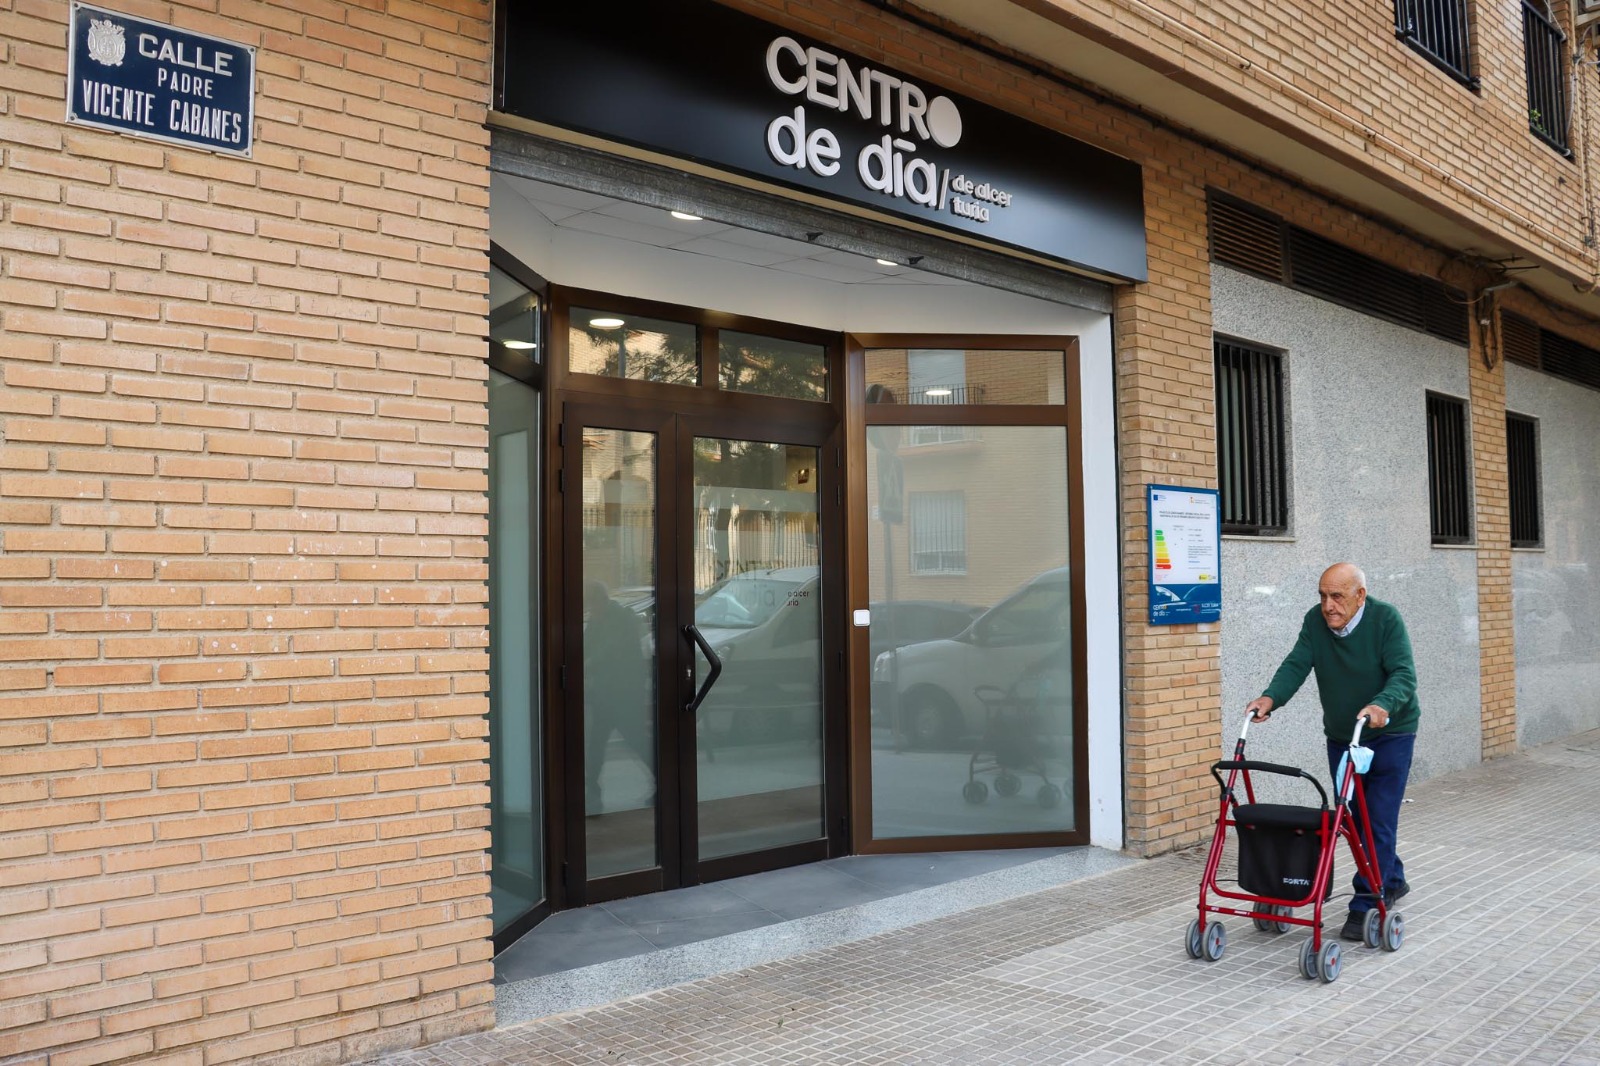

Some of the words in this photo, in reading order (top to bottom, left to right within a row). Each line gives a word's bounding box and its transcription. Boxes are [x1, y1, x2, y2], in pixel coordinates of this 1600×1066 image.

[138, 32, 233, 77] CALLE
[157, 67, 214, 99] PADRE
[765, 36, 963, 149] CENTRO
[82, 79, 156, 126] VICENTE
[169, 99, 242, 144] CABANES
[767, 105, 841, 177] de
[952, 174, 974, 195] de
[974, 182, 1013, 207] alcer
[952, 196, 990, 222] turia
